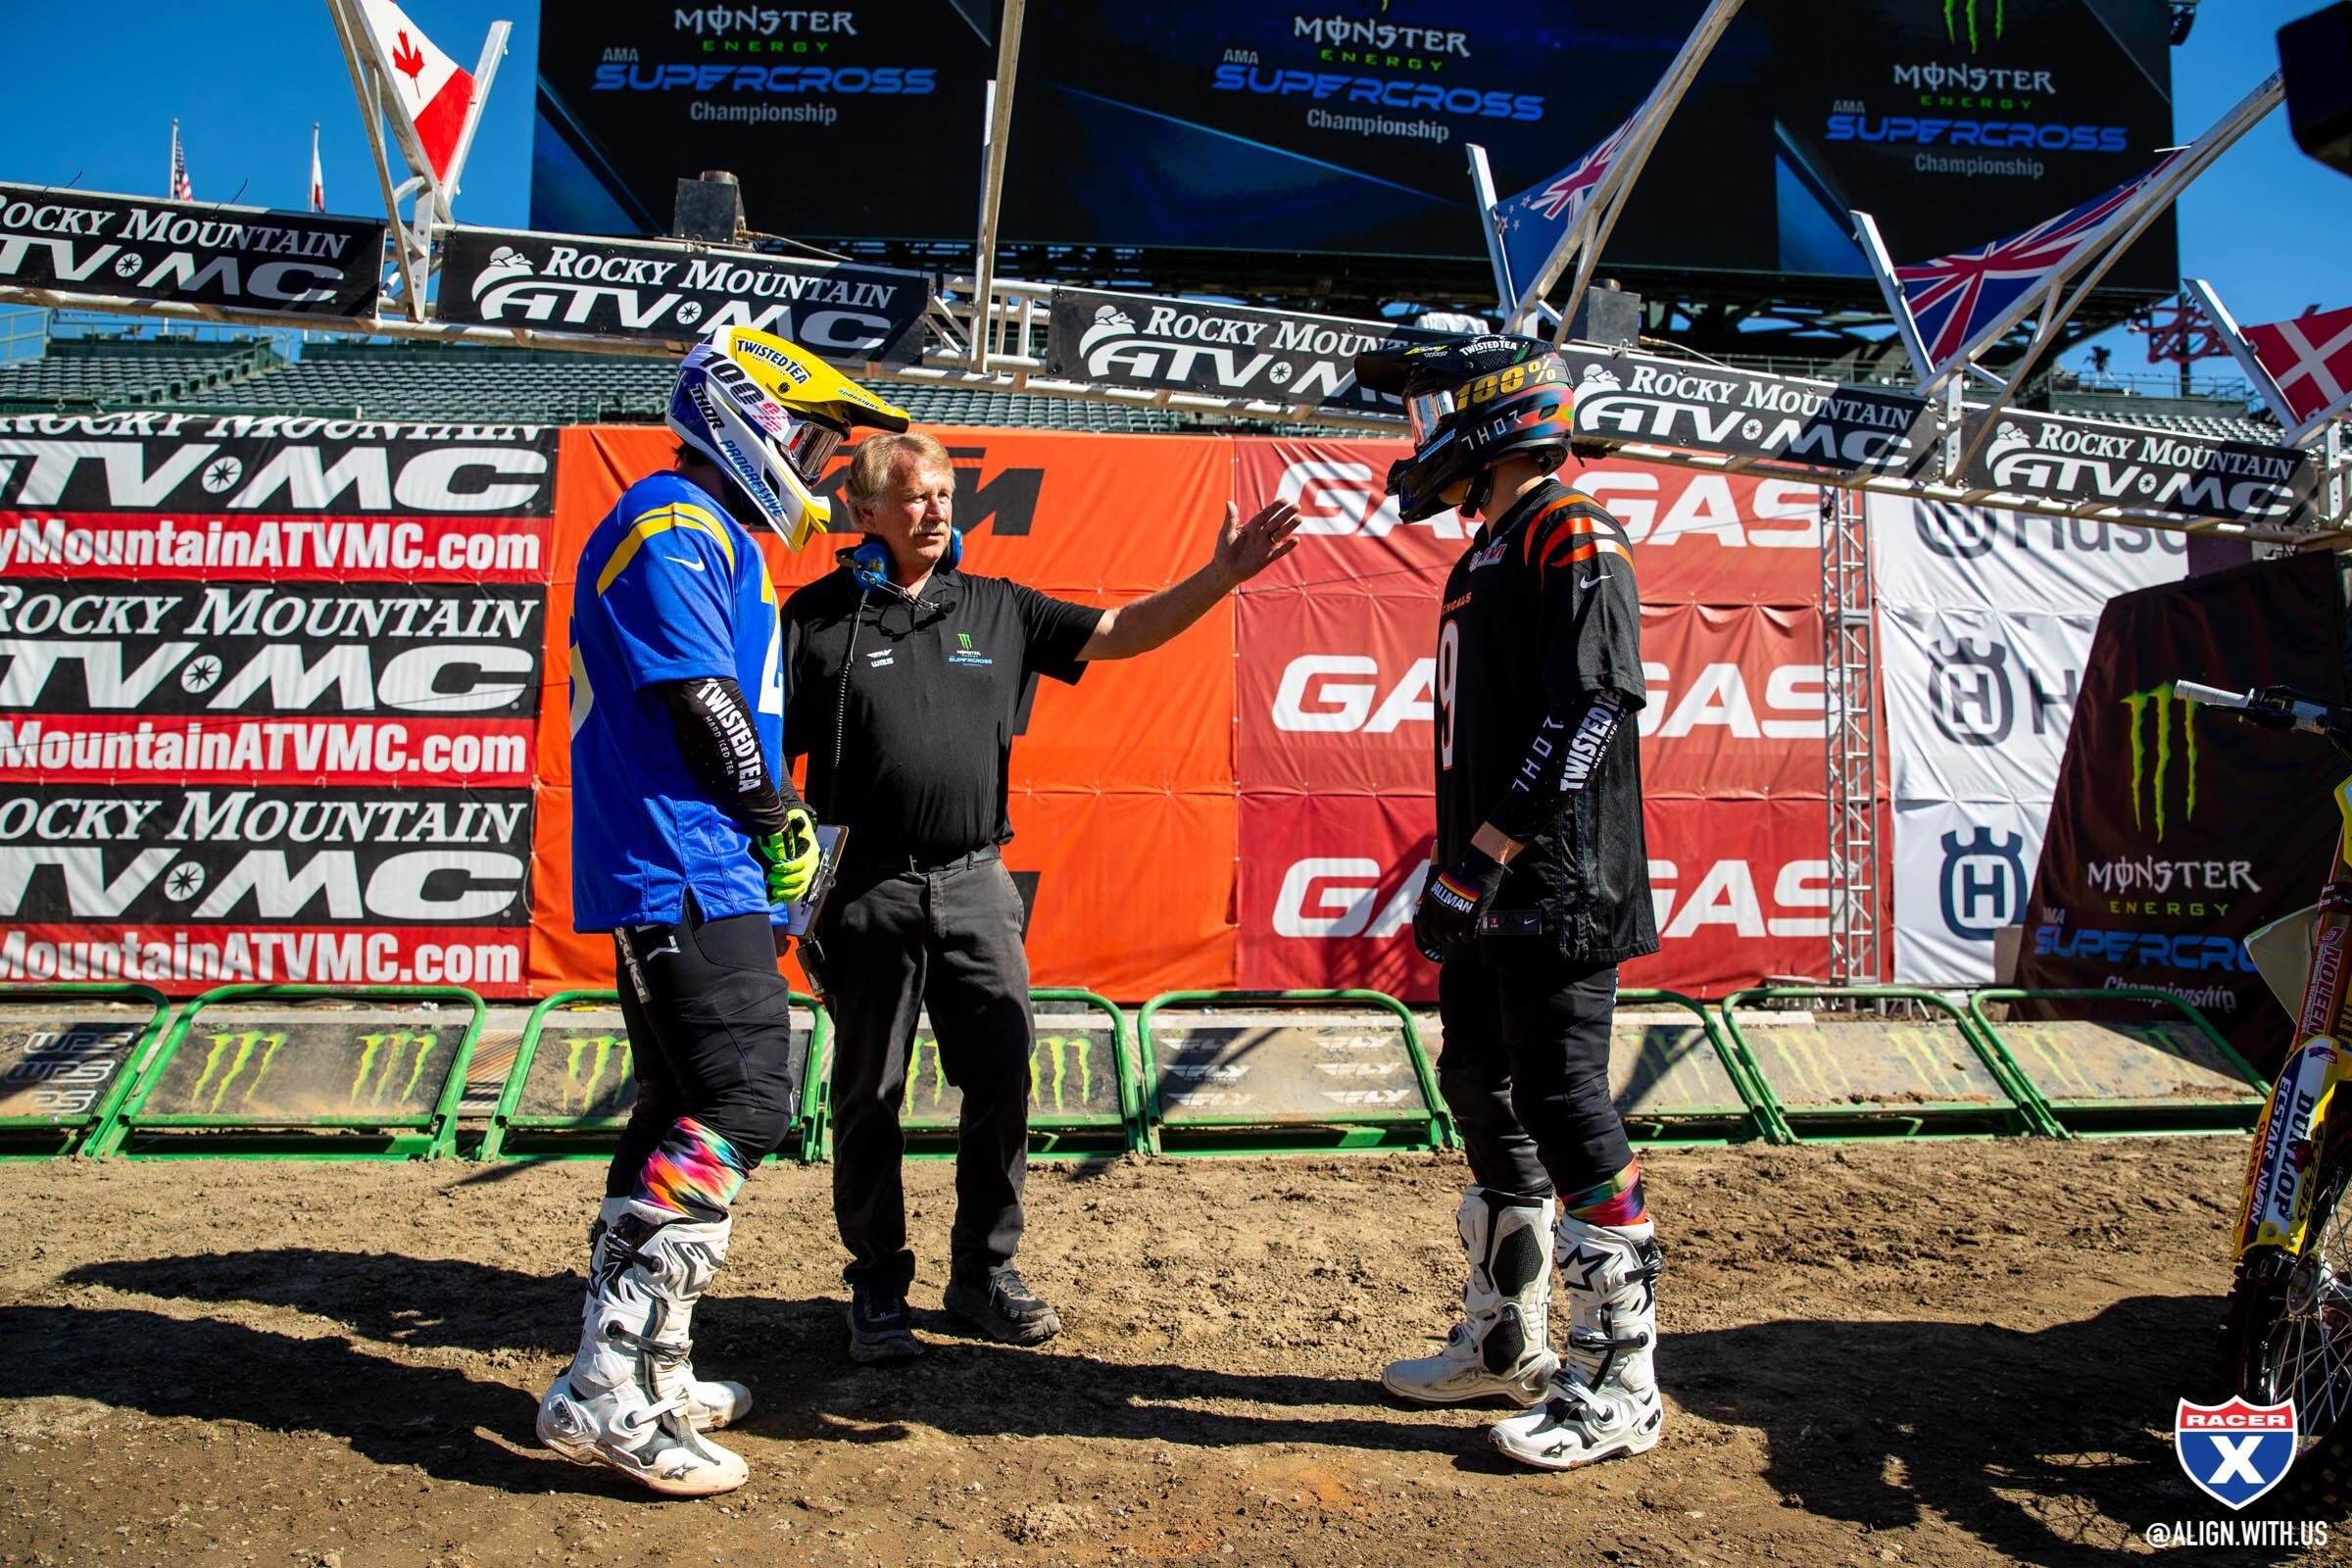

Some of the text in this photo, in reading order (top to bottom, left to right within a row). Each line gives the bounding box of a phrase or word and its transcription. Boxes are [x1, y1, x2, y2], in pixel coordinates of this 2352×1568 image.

[674, 4, 857, 36] MONSTER
[1294, 15, 1470, 58] MONSTER
[603, 48, 639, 63] AMA
[703, 40, 829, 53] ENERGY
[1223, 49, 1258, 65] AMA
[1321, 49, 1444, 72] ENERGY
[592, 65, 938, 93] SUPERCROSS
[1212, 65, 1544, 121] SUPERCROSS
[1893, 62, 2055, 94] MONSTER
[691, 102, 838, 125] Championship
[1833, 100, 1866, 114] AMA
[1921, 95, 2032, 110] ENERGY
[1307, 109, 1449, 143] Championship
[1825, 116, 2128, 152] SUPERCROSS
[1915, 153, 2044, 178] Championship
[0, 195, 351, 259] OCKY MOUNTAIN
[541, 246, 897, 310] ROCKY MOUNTAIN
[1143, 306, 1267, 347] ROCKY
[1459, 340, 1498, 356] TWISTED
[1498, 340, 1517, 350] TEA
[737, 339, 808, 384] TWISTED TEA
[689, 383, 725, 431] THOR
[699, 351, 792, 433] 100%
[1454, 359, 1556, 411] 100%
[1627, 365, 1913, 430] ROCKY MOUNTAIN
[2035, 421, 2294, 480] ROCKY MOUNTAIN
[719, 440, 788, 517] PROGRESSIVE
[183, 588, 539, 638] MOUNTAIN
[1441, 592, 1469, 615] ENGALS
[1439, 619, 1458, 771] 9
[697, 678, 760, 793] TWISTED TEA
[706, 716, 735, 775] HARD ICED TEA
[1560, 707, 1613, 791] TWISTED
[1593, 708, 1627, 769] HARD ICED TEA
[165, 792, 527, 843] MOUNTAIN
[2087, 855, 2262, 894] MONSTER
[2110, 901, 2229, 916] ENERGY
[2307, 946, 2342, 1036] NOLEEN
[2265, 1076, 2291, 1159] ECSTAR
[2275, 1090, 2315, 1221] DUNLOP
